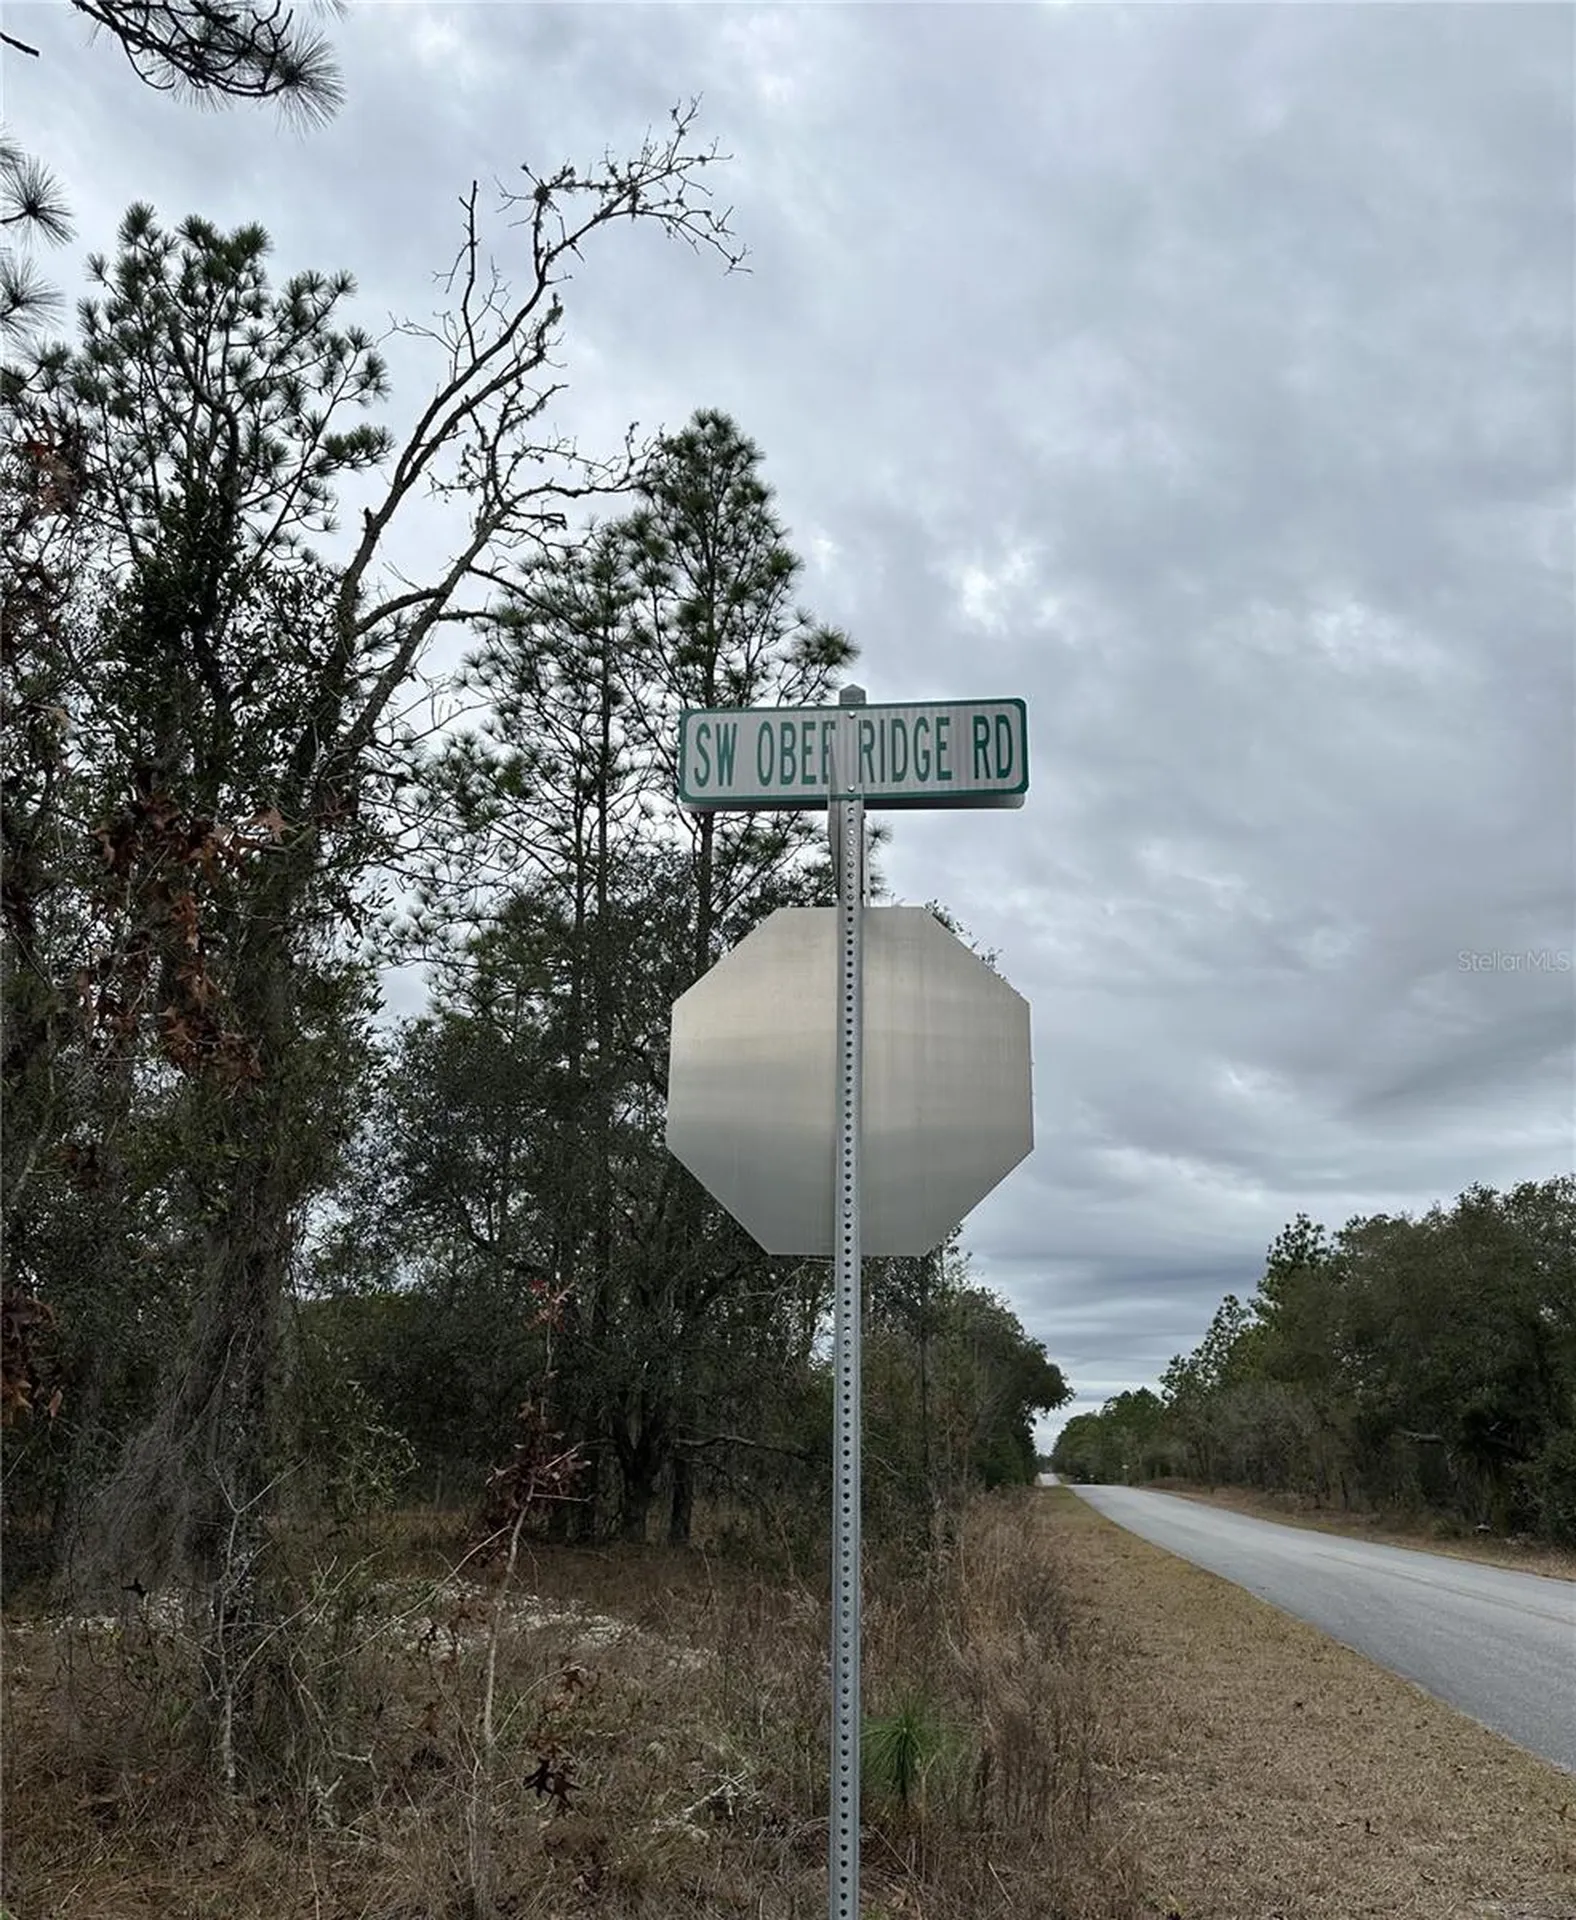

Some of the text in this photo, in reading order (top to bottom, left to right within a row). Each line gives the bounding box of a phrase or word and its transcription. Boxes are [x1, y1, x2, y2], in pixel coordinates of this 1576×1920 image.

[694, 722, 737, 787] SW
[858, 716, 953, 784] RIDGE
[973, 714, 1013, 780] RD
